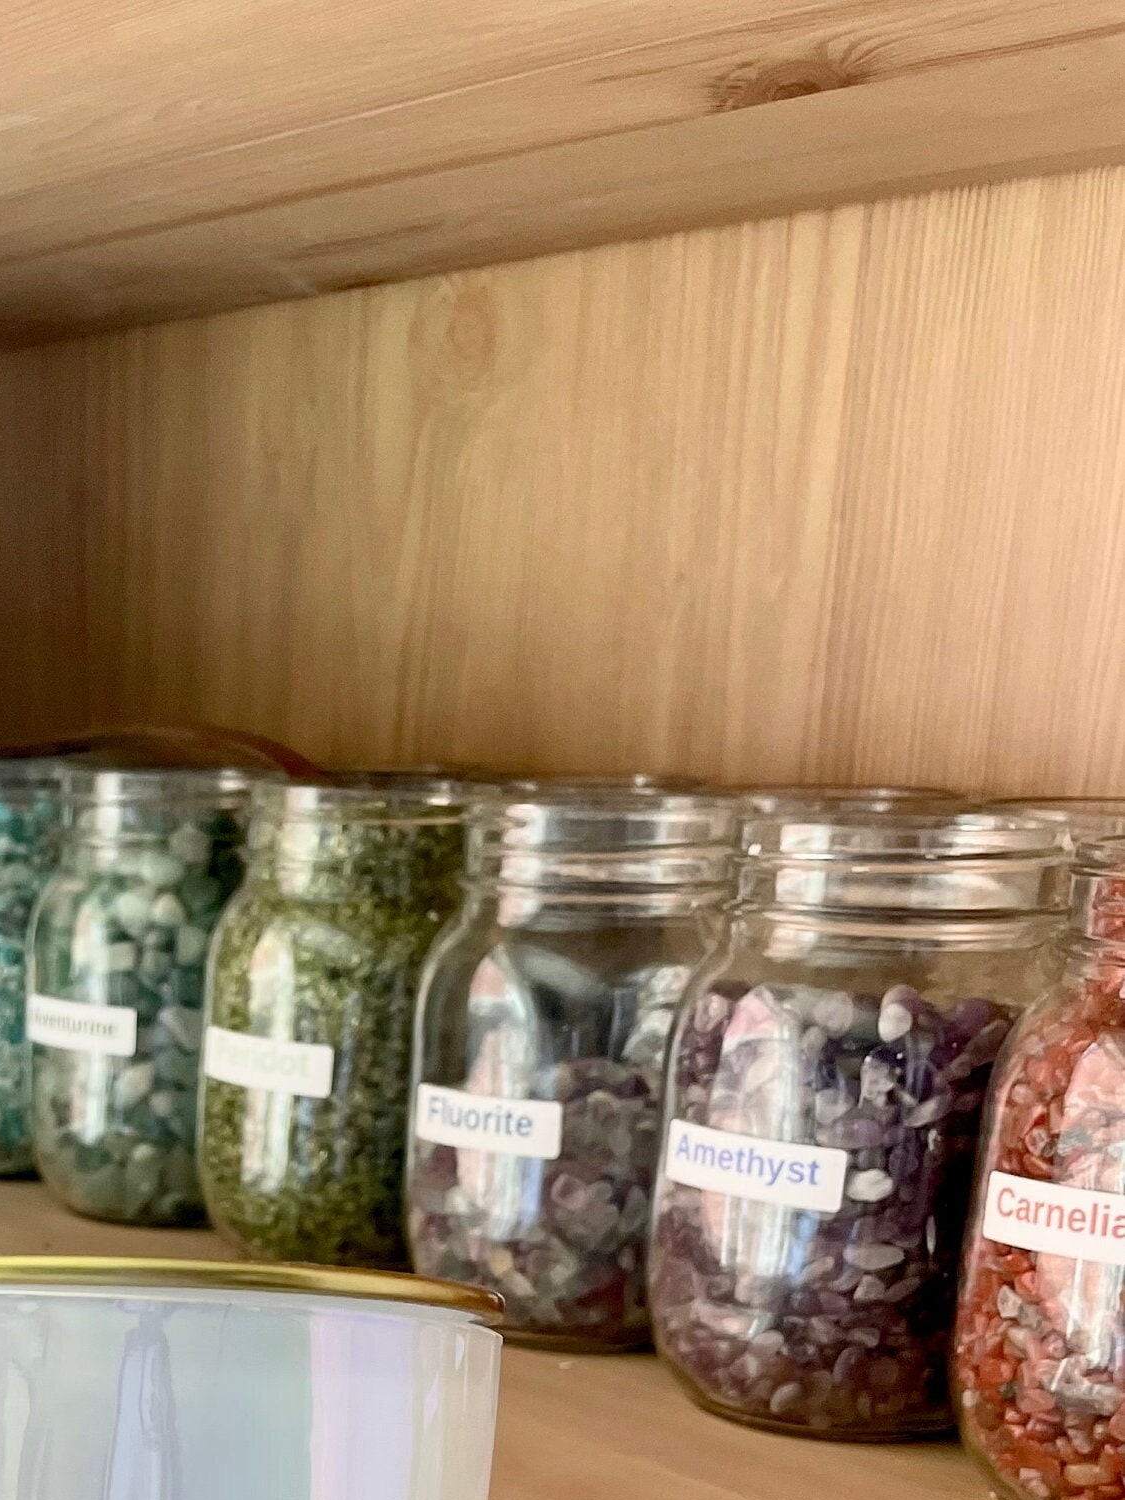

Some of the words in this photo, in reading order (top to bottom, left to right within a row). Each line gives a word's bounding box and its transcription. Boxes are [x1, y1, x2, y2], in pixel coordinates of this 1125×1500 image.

[427, 1094, 534, 1138] Fluorite
[675, 1133, 820, 1187] Amethyst
[996, 1187, 1125, 1239] Carnelia
